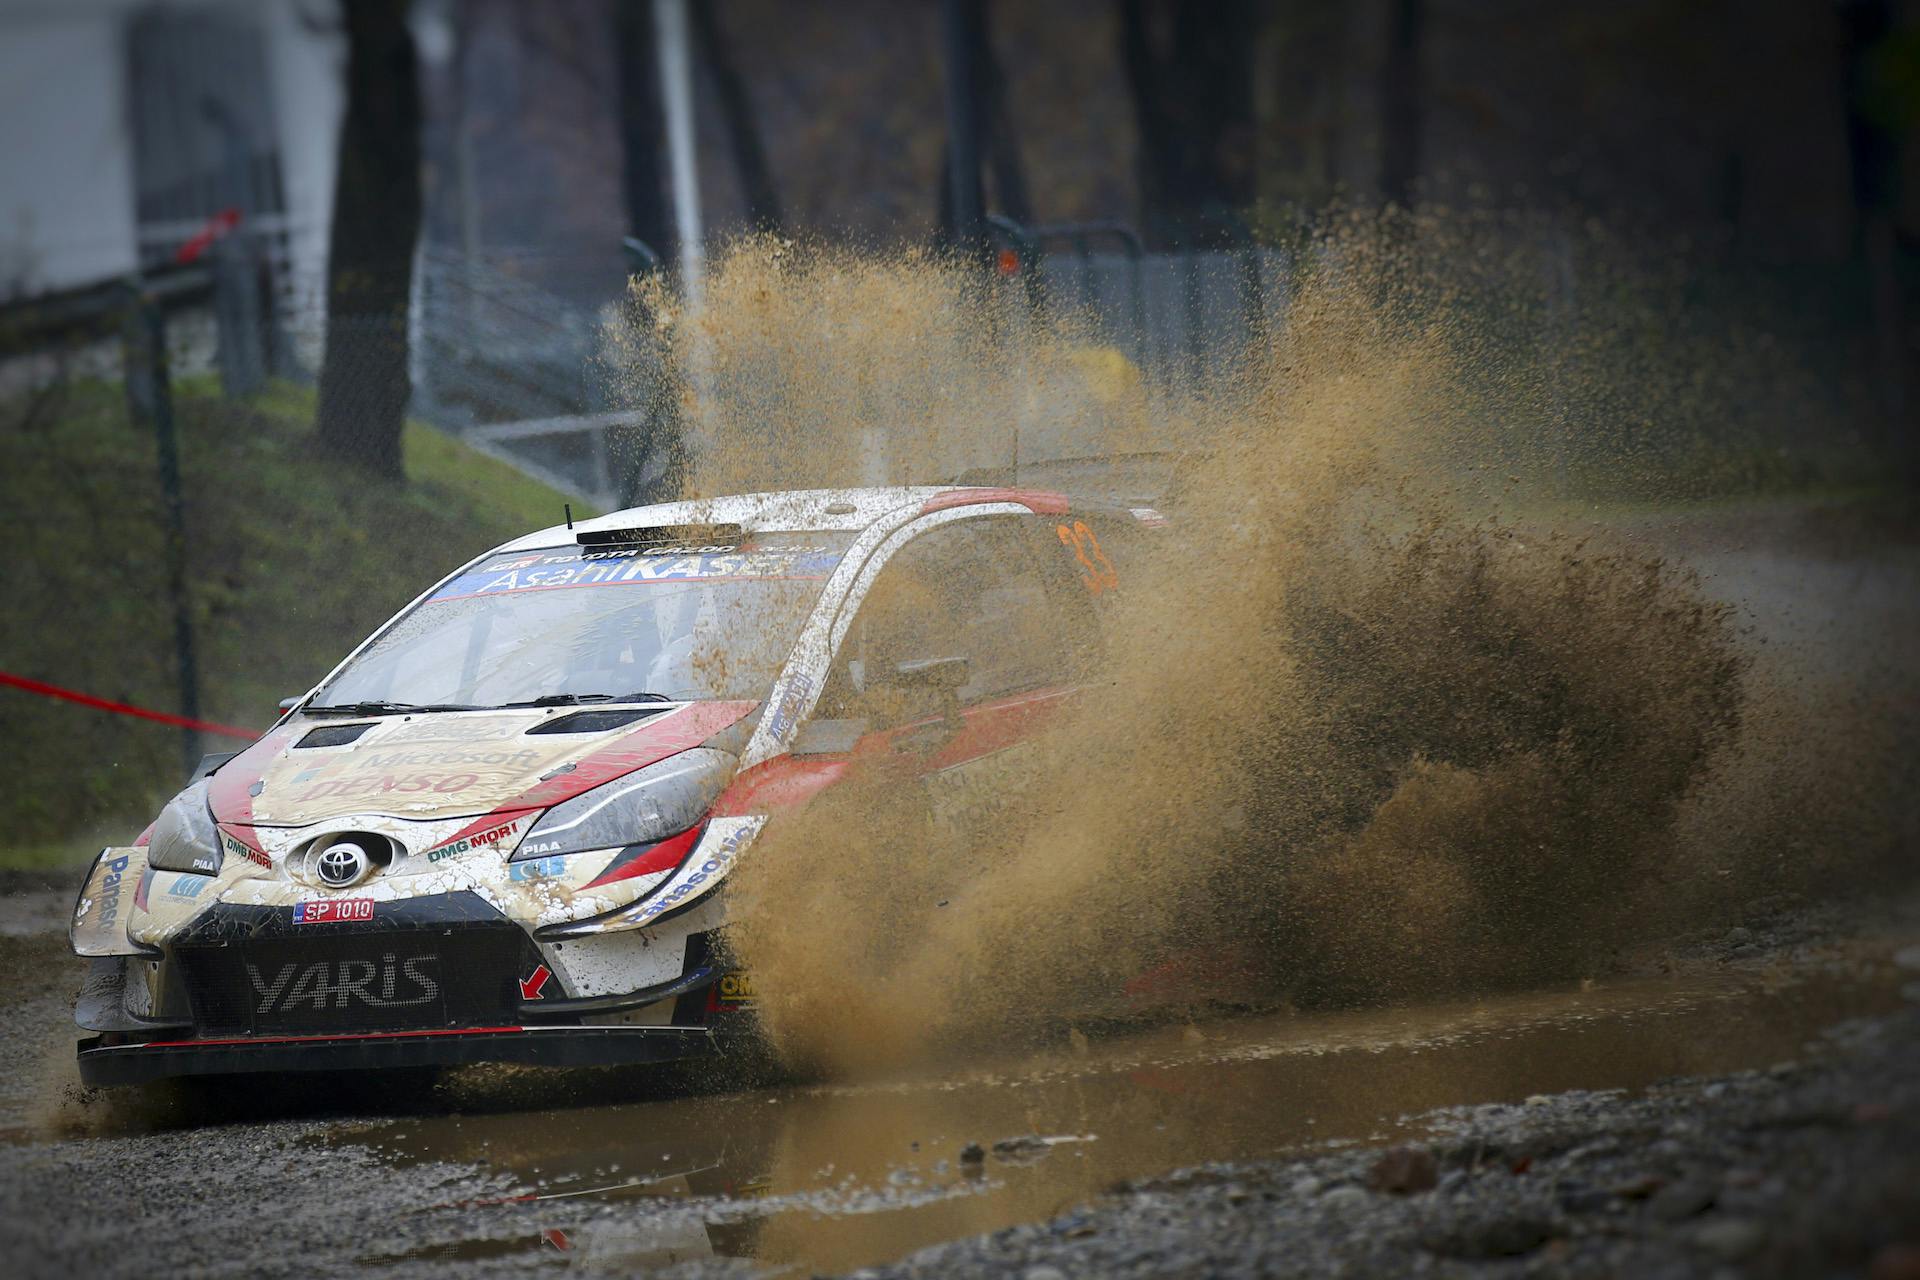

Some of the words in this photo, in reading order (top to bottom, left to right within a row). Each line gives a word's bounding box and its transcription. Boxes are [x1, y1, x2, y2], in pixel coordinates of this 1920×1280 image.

[543, 549, 637, 564] TOYOTA
[358, 749, 541, 770] Microsoft
[294, 774, 480, 803] DENSO
[427, 841, 468, 863] DMG
[470, 827, 519, 849] MORI
[522, 841, 562, 856] PIAA
[193, 858, 214, 871] PIAA
[247, 850, 272, 870] MORI
[305, 903, 330, 920] SP
[335, 901, 370, 919] 1010
